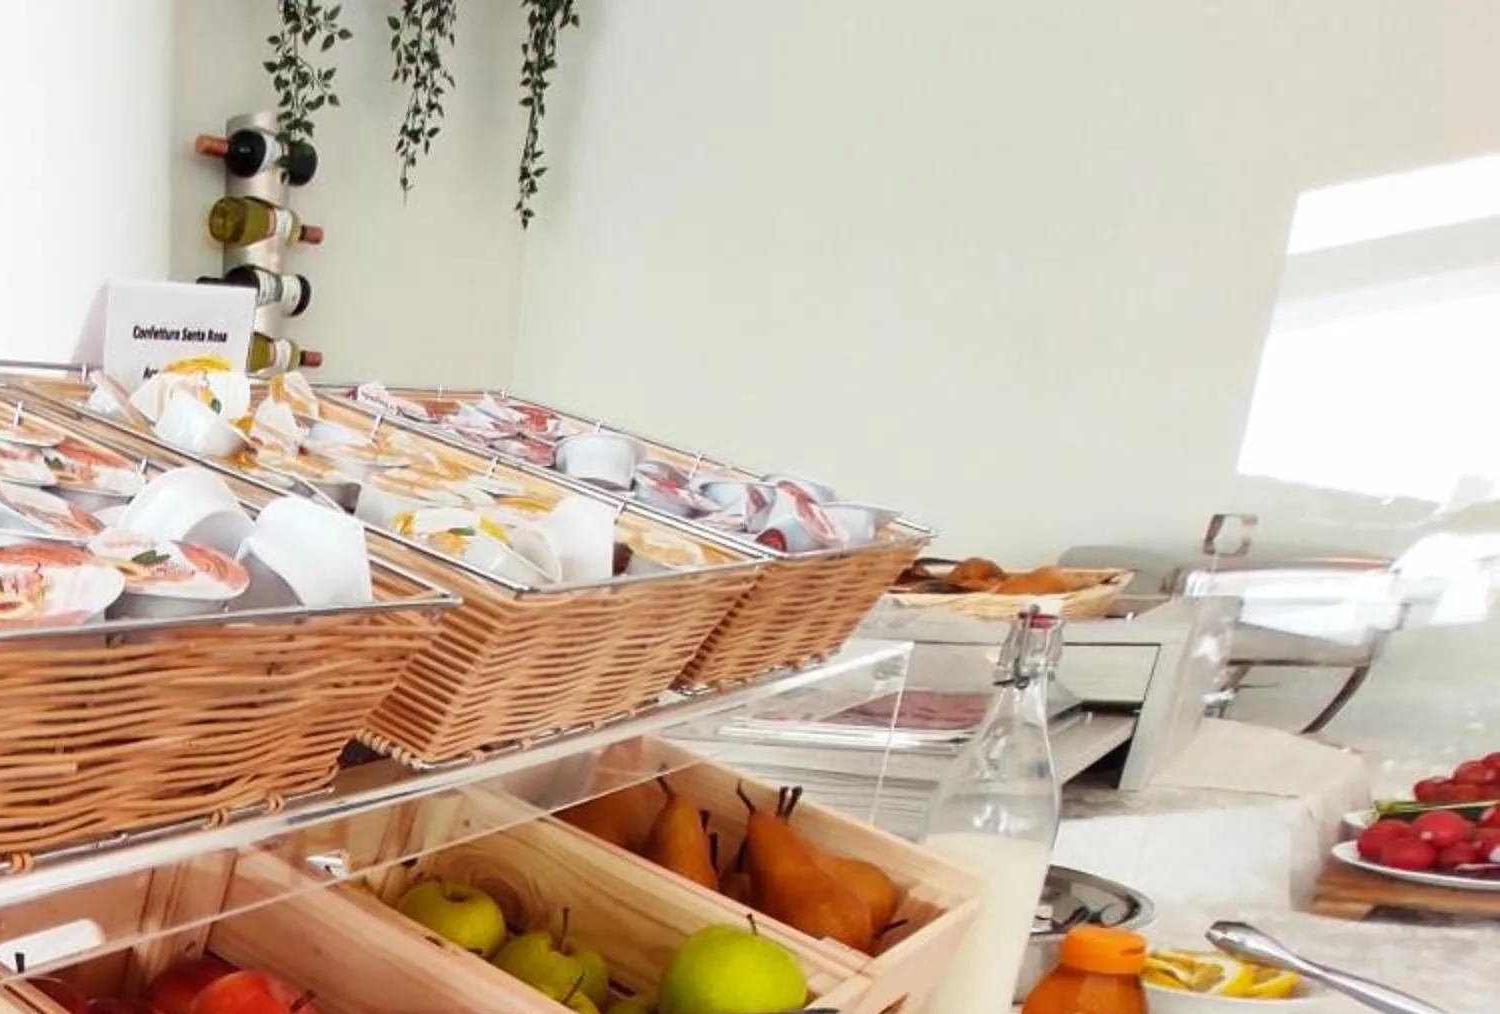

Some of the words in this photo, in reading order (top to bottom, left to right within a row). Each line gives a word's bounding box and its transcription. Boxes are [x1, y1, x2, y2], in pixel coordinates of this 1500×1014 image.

[132, 324, 180, 341] Confettura
[181, 326, 206, 342] Santa
[207, 328, 228, 343] Rosa
